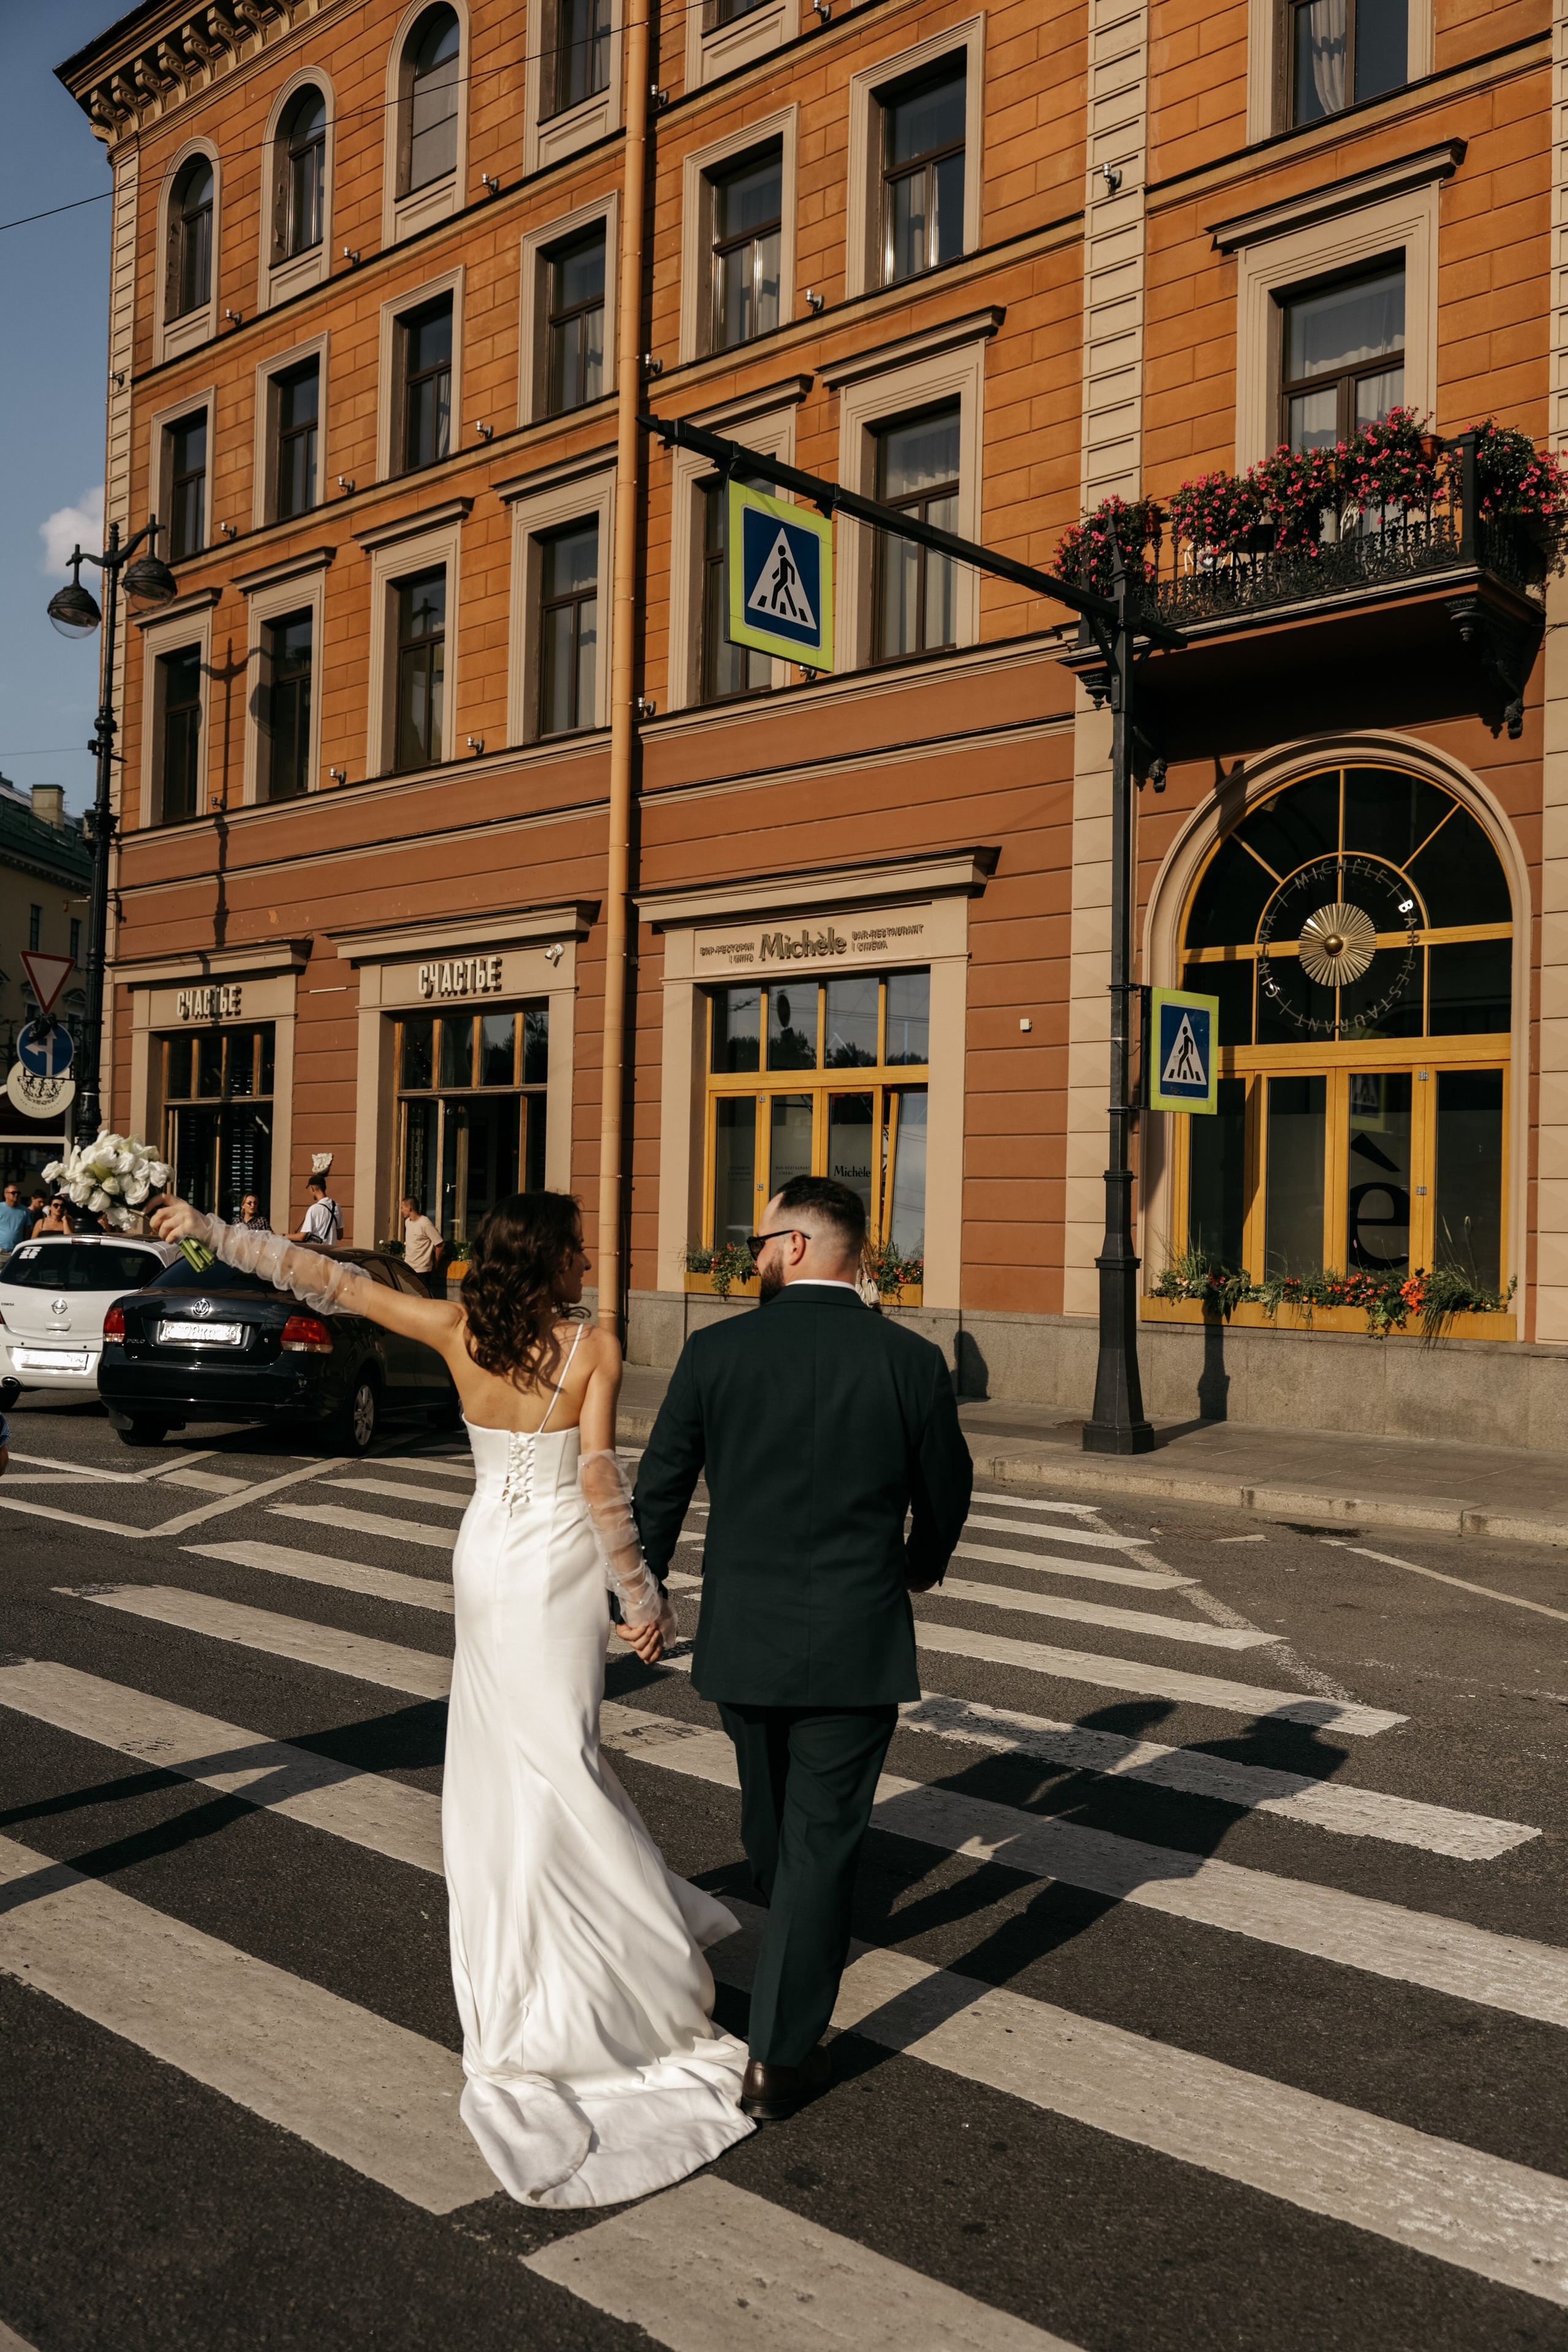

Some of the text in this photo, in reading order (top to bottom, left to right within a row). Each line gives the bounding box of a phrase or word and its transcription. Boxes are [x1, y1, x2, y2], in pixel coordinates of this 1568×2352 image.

[852, 924, 924, 941] BAR-RESTAURANT
[1398, 899, 1420, 944] BAR
[758, 927, 847, 960] Michèle
[418, 956, 501, 995] СЧАСТЬЕ
[176, 986, 240, 1017] СЧАСТЬЕ
[1295, 959, 1417, 1035] RESTAURANT
[834, 1166, 872, 1177] Michèle
